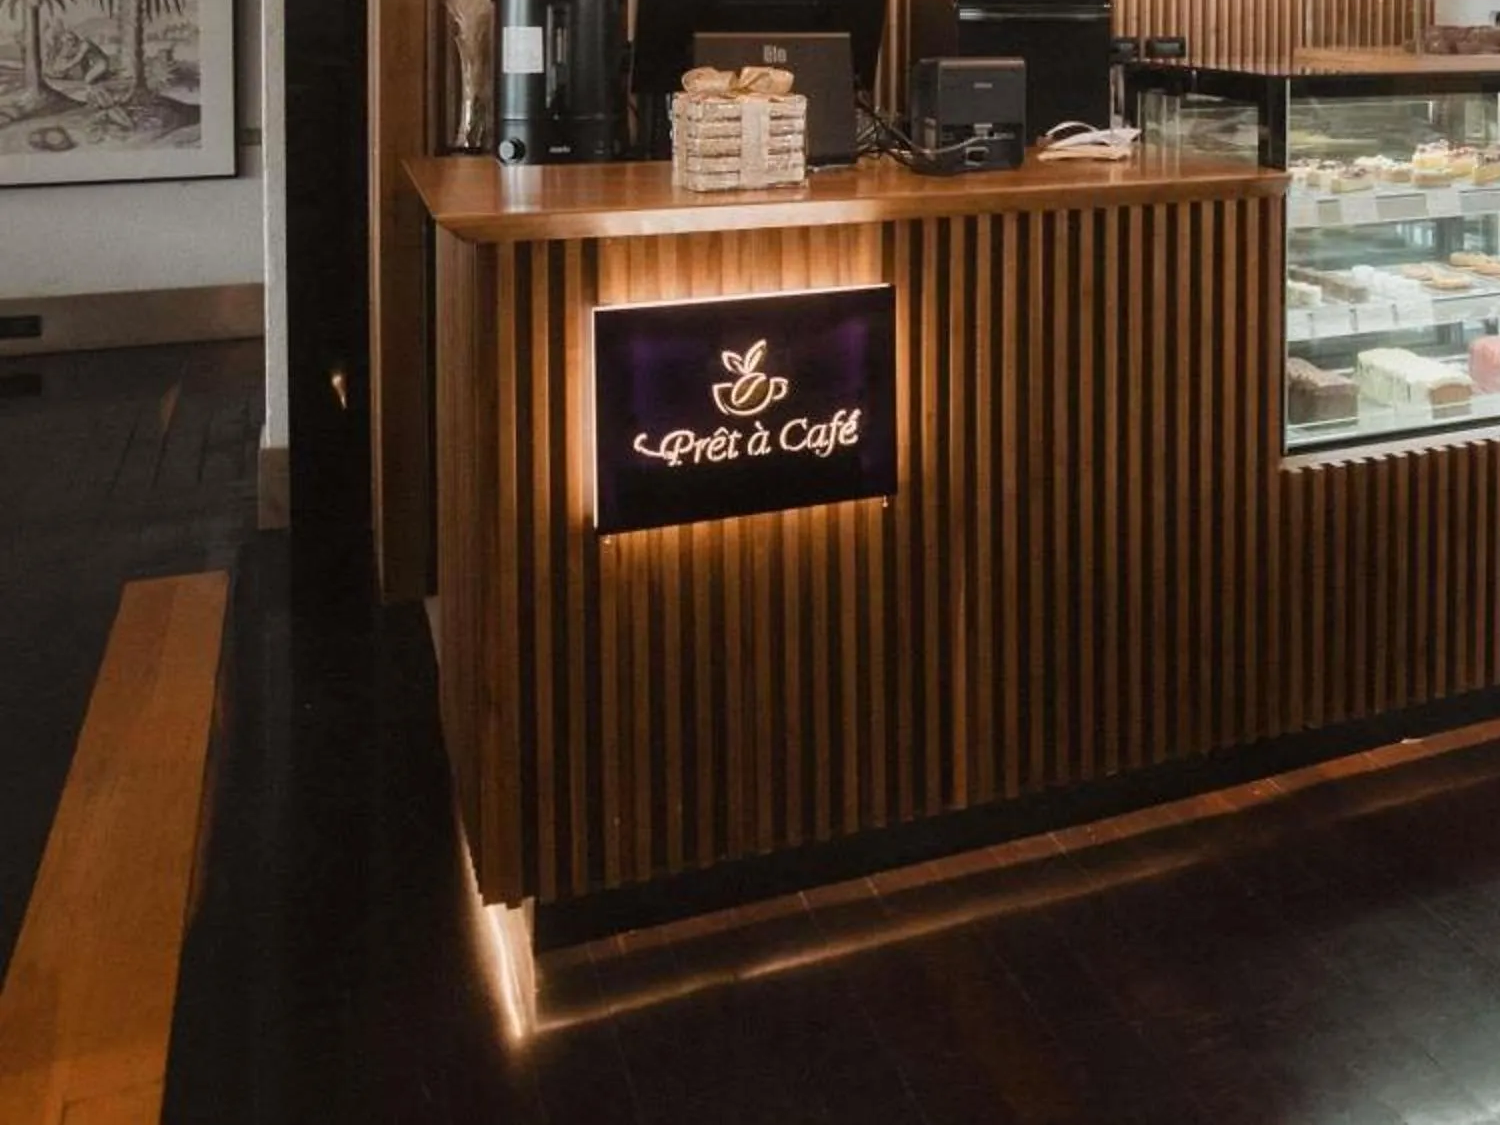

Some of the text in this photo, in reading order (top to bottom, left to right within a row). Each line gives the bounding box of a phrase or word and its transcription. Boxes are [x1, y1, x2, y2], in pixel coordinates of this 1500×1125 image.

[634, 408, 863, 467] Prêt à Café
